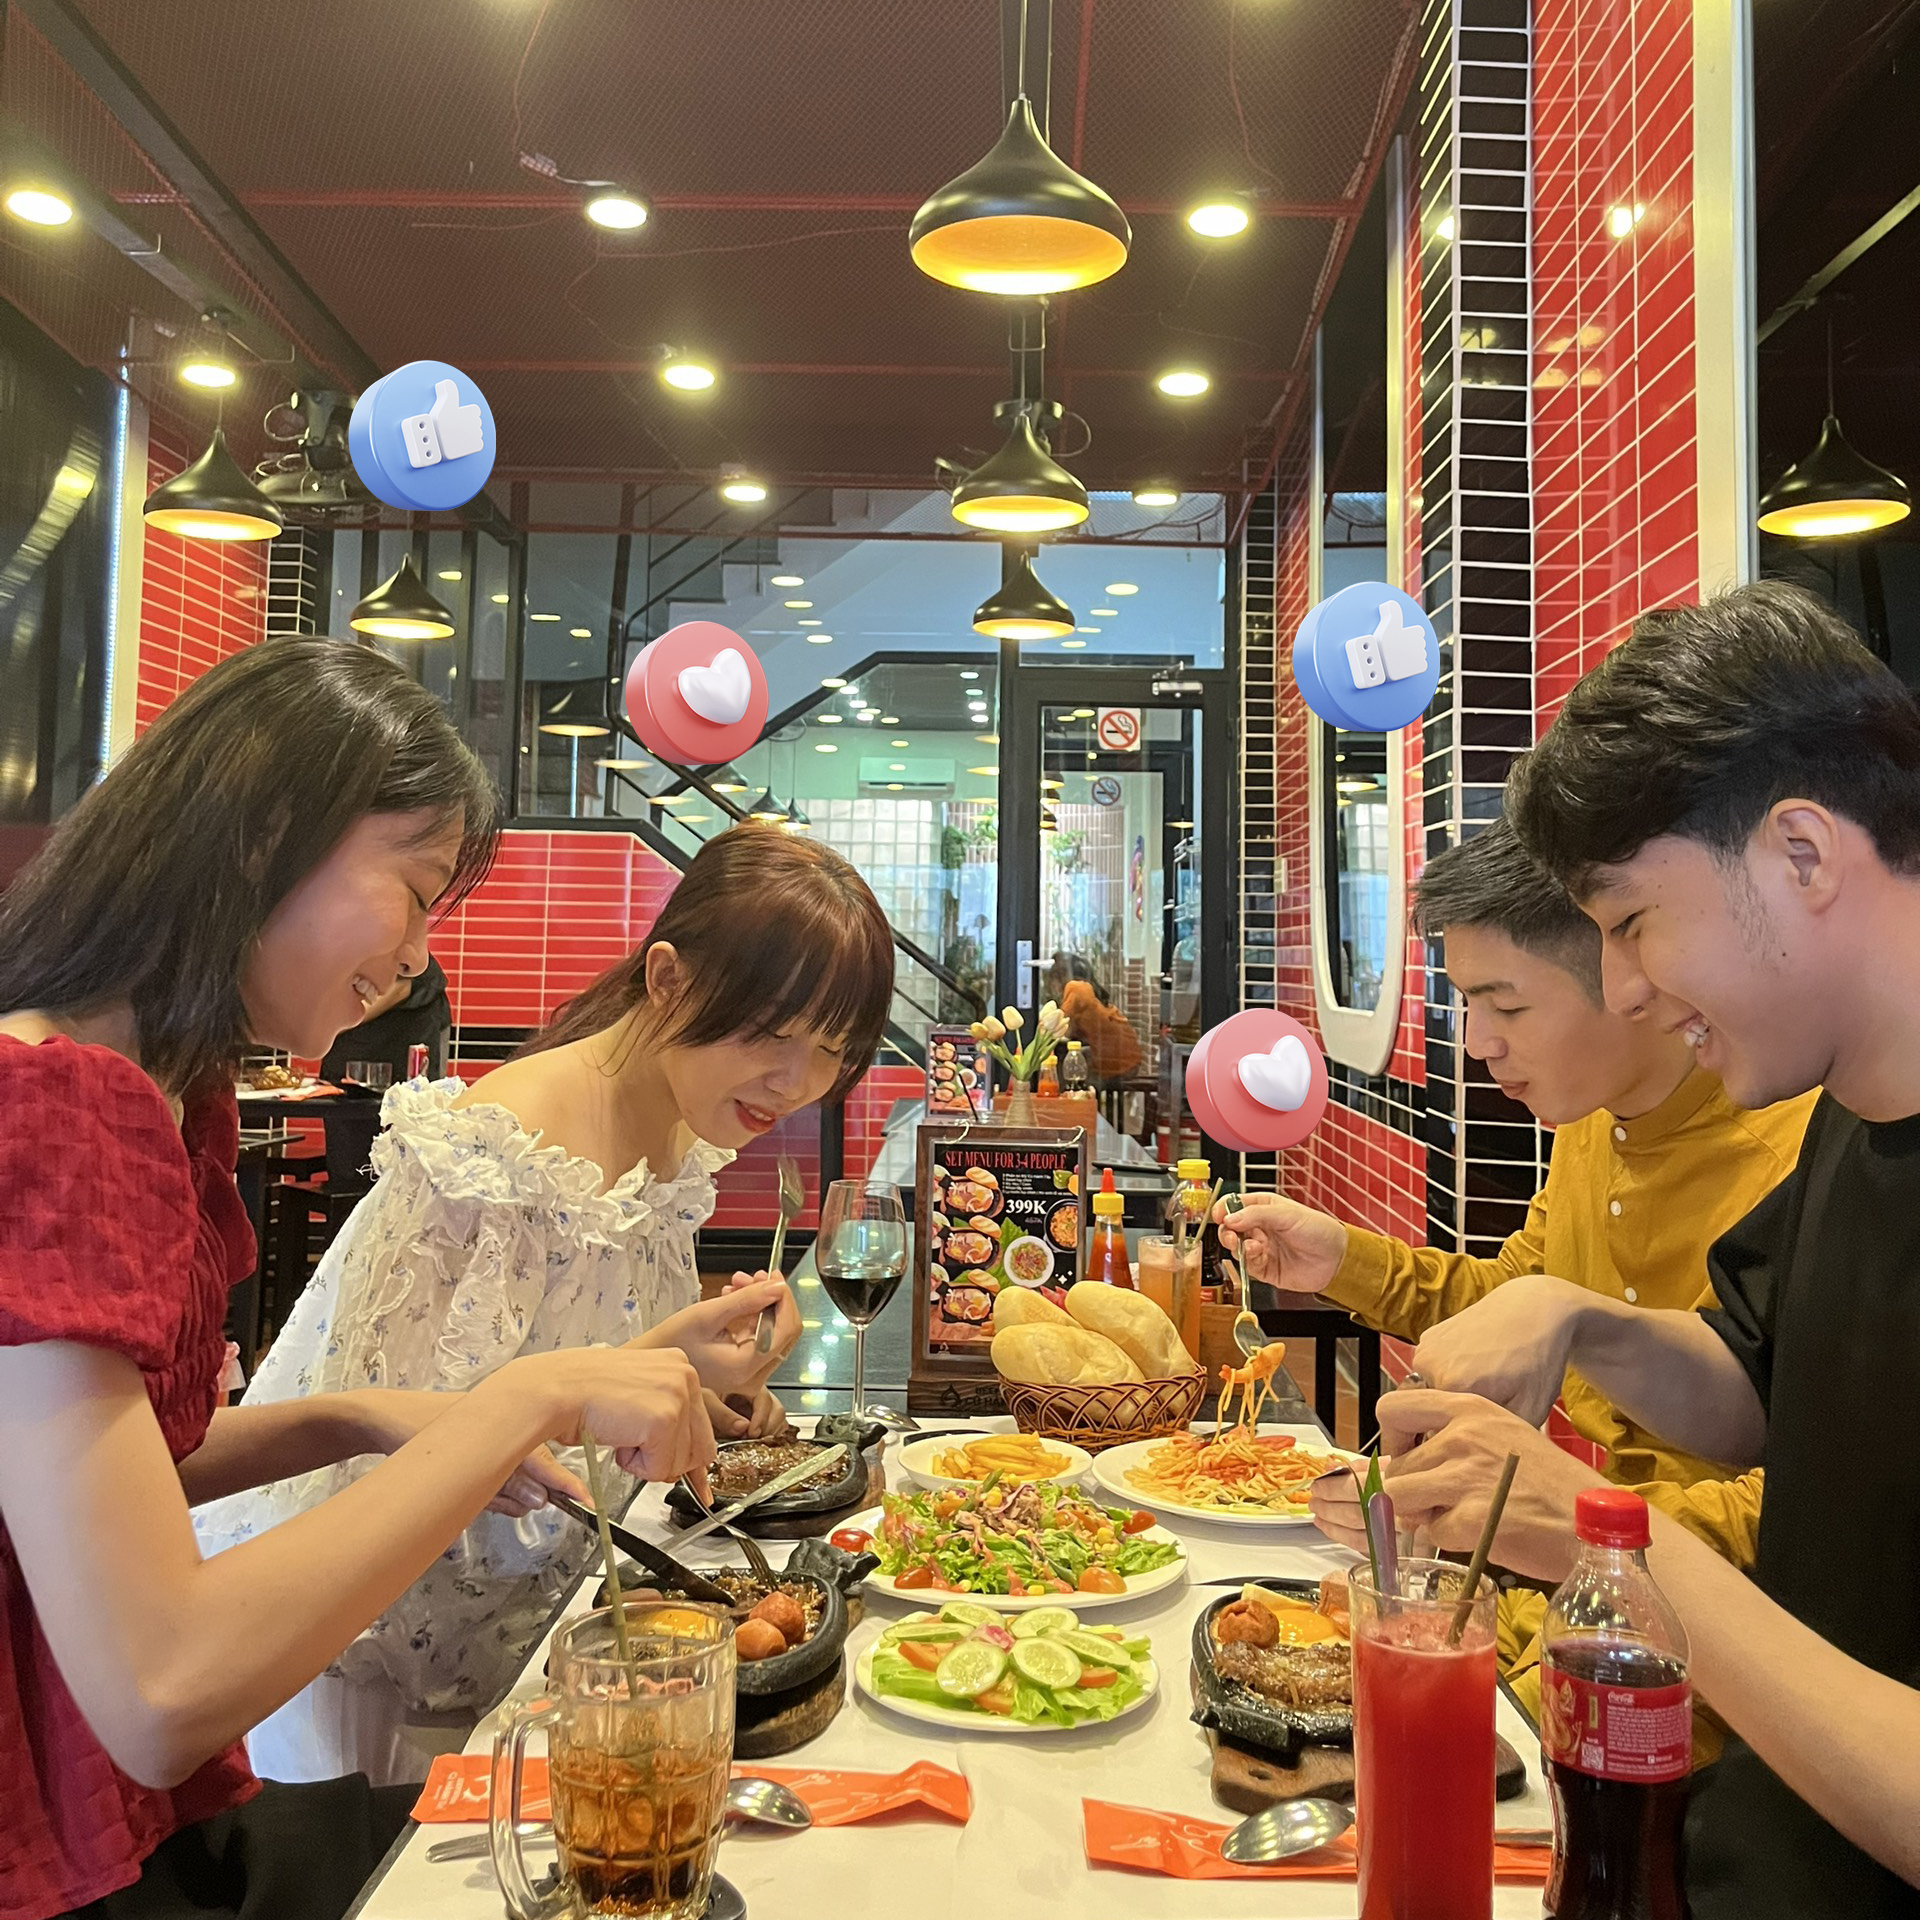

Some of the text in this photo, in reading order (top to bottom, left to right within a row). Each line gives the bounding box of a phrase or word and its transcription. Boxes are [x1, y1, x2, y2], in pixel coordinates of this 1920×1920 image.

[946, 1151, 1067, 1169] SET MENU FOR 3-4 PEOPLE
[1006, 1199, 1047, 1214] 399K
